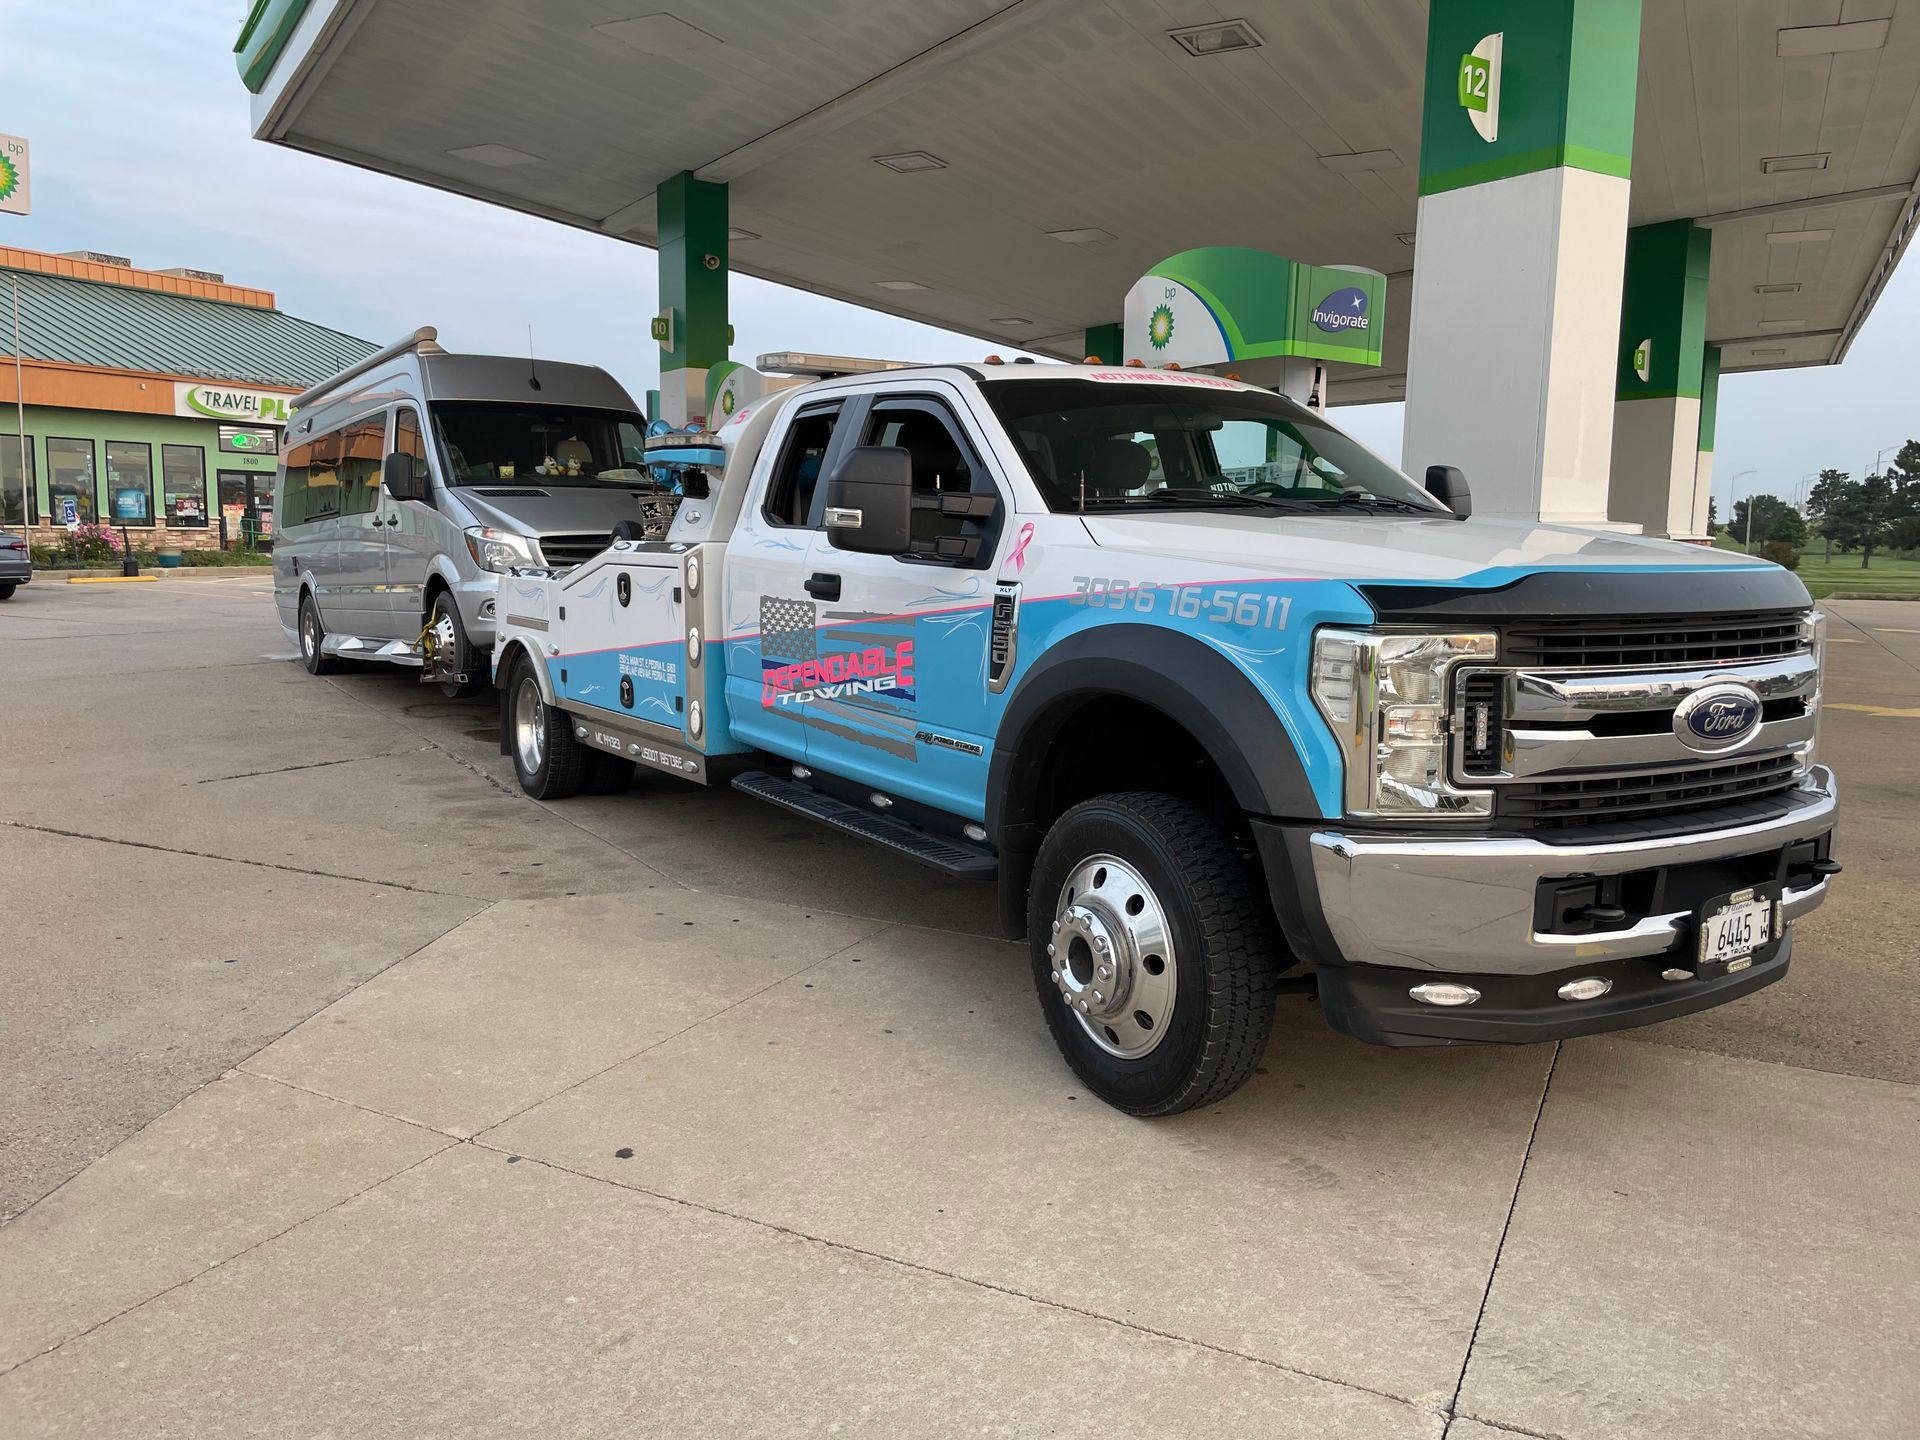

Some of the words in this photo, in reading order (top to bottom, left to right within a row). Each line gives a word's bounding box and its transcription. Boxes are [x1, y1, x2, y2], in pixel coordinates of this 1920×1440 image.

[1464, 64, 1487, 98] 12
[8, 140, 24, 156] bp
[1164, 286, 1177, 299] bp
[653, 321, 667, 335] 10
[1312, 309, 1369, 330] Invigorate
[1637, 353, 1643, 365] 8
[1090, 373, 1163, 381] NOTHING
[204, 390, 258, 411] TRAVEL
[260, 397, 299, 420] PL
[762, 639, 914, 708] DEPENDABLE
[777, 675, 897, 705] TOWING
[1704, 702, 1747, 732] Ford
[933, 735, 955, 746] POWER
[955, 740, 981, 753] STROKE
[641, 747, 659, 764] USDOT
[1717, 913, 1753, 951] 6445
[1731, 945, 1751, 955] TRUCK
